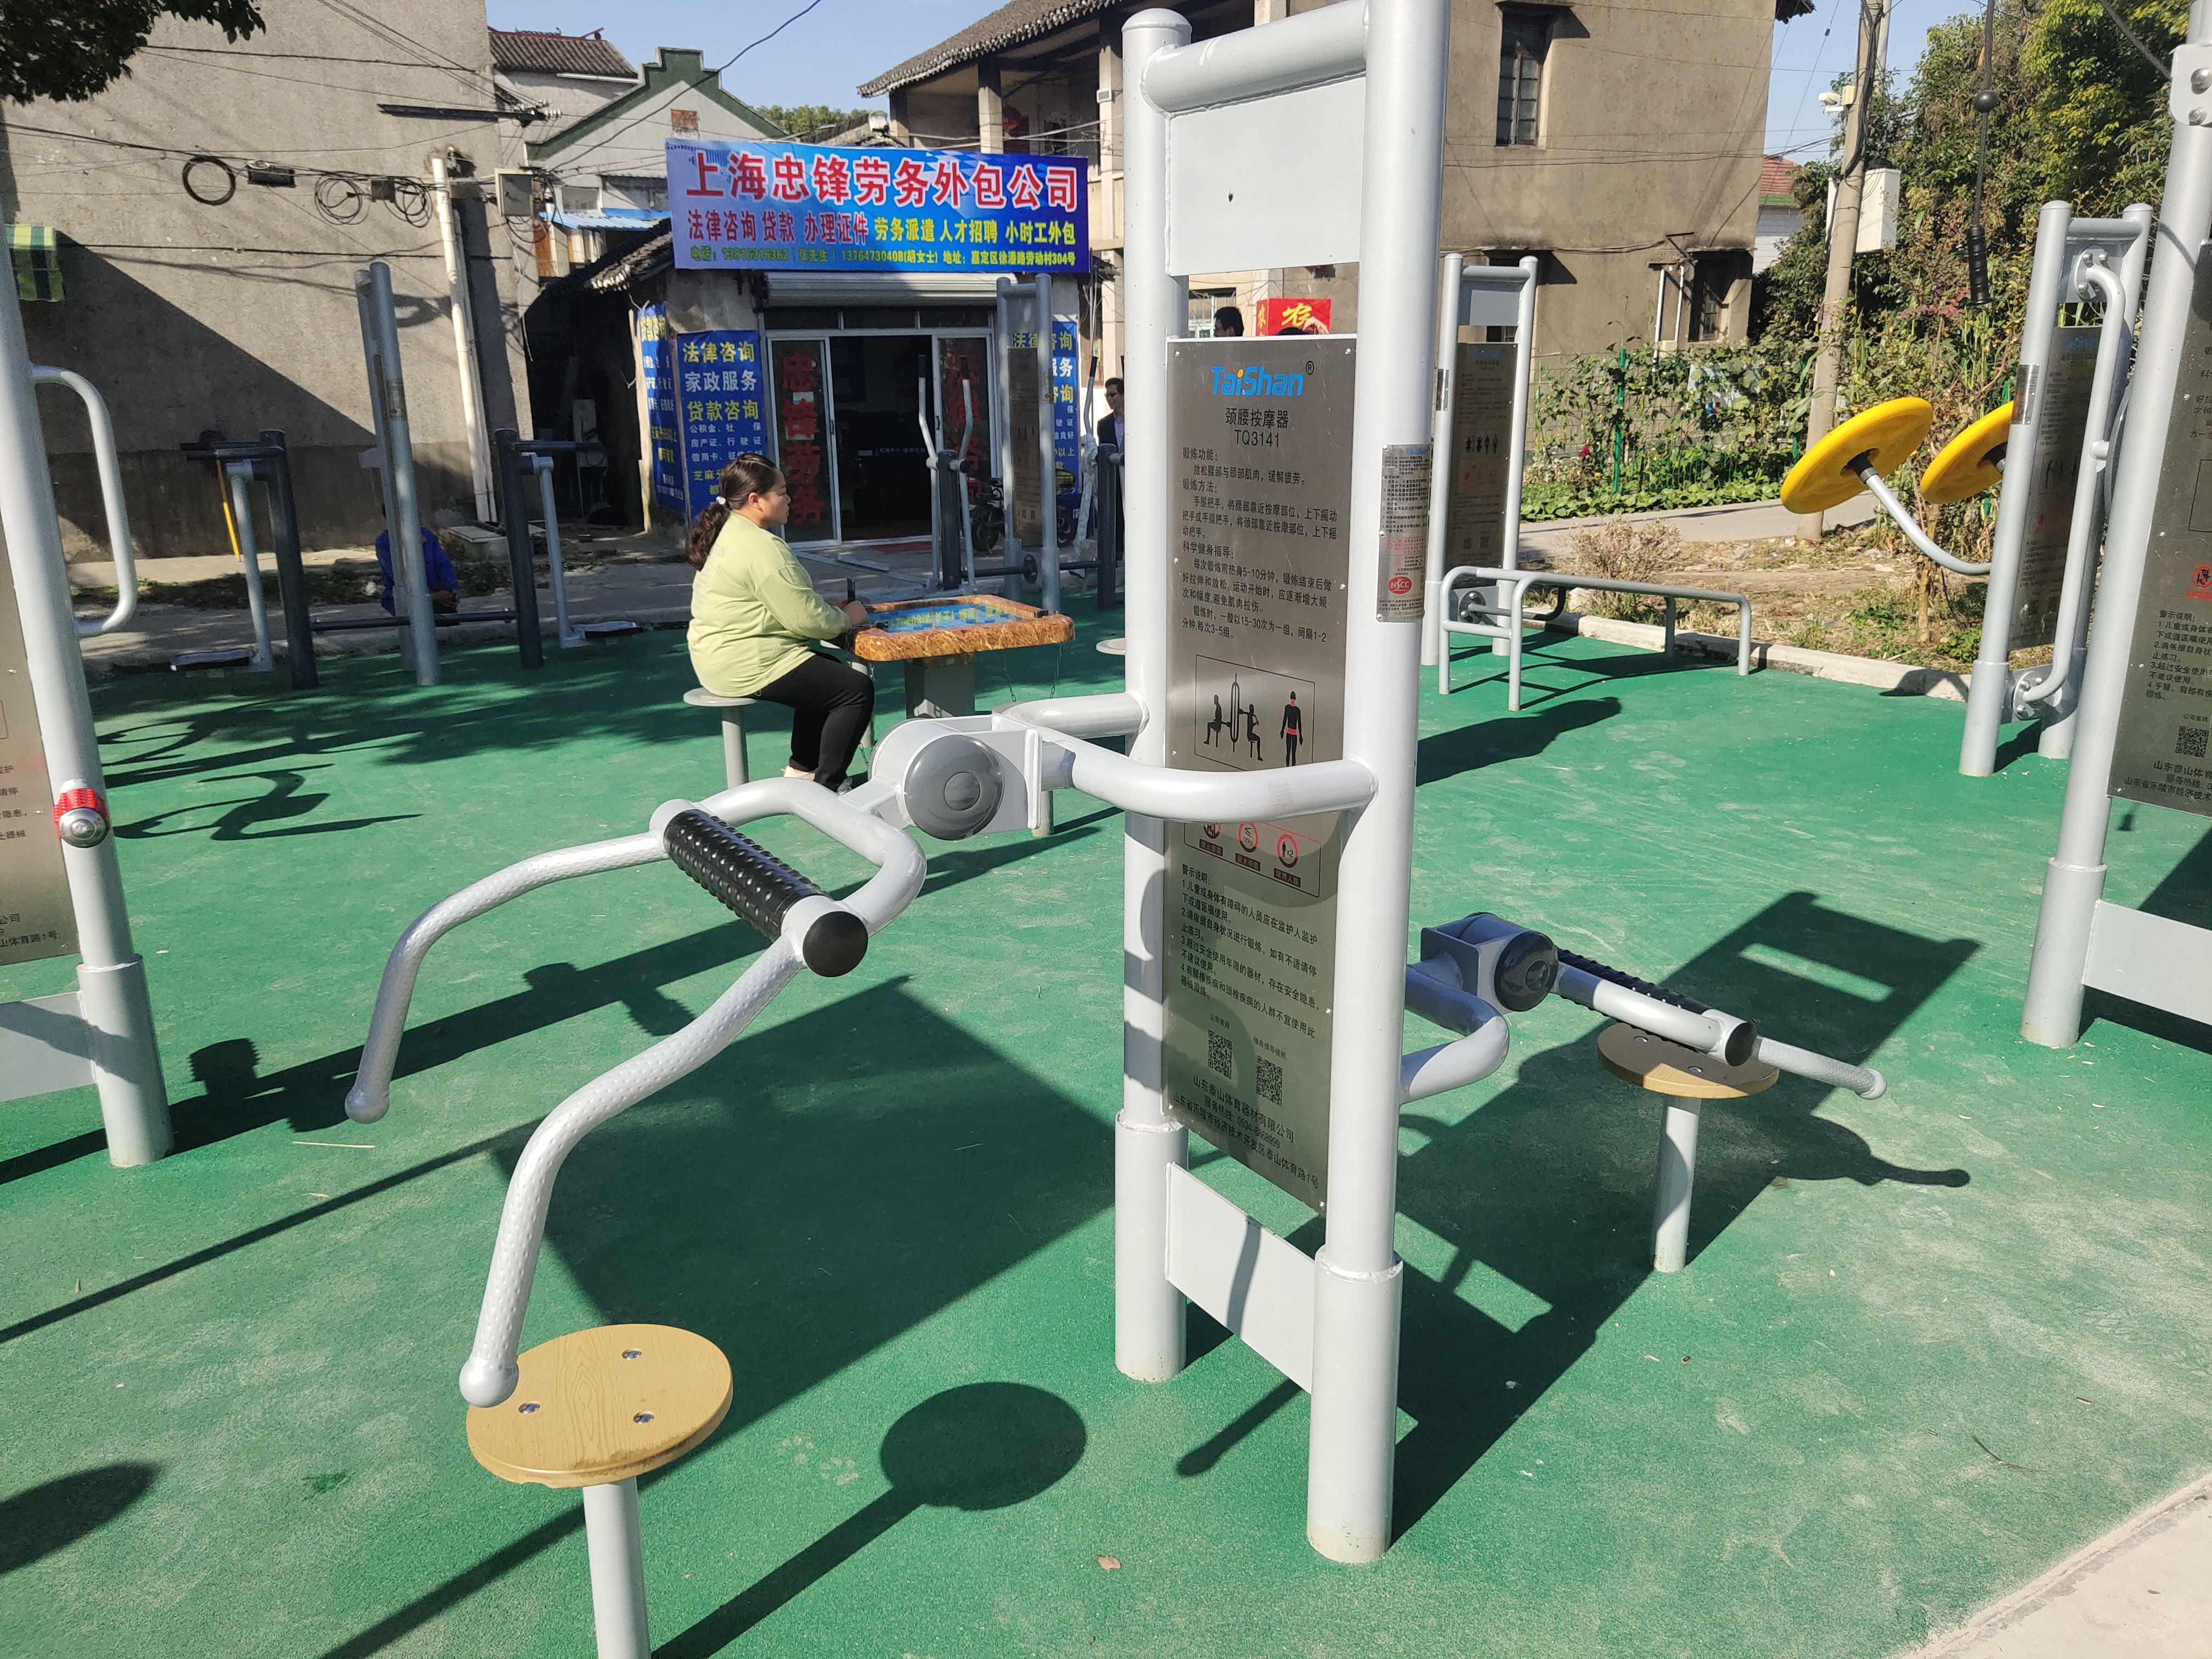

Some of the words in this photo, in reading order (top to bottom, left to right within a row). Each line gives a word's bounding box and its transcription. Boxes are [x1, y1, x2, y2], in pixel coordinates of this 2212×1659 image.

[686, 152, 1076, 210] 上海忠锋劳务外包公司
[687, 210, 756, 242] 法律咨询
[763, 213, 795, 241] 贷款
[804, 213, 868, 246] 办理证件
[874, 217, 935, 242] 劳务派遣
[939, 218, 998, 244] 人才招聘
[1005, 219, 1076, 245] 小时工外包
[682, 341, 755, 363] 法律咨询
[685, 369, 757, 392] 家政服务
[1211, 366, 1304, 396] TaiShan
[687, 399, 759, 422] 贷款咨询
[1225, 408, 1289, 429] 颈腰按摩器
[1234, 430, 1280, 448] TQ3141
[1182, 447, 1218, 462] 锻炼功能：
[1182, 479, 1218, 494] 锻炼方法：
[1182, 526, 1207, 540] 动把手。
[1182, 540, 1234, 560] 科学健身指导：
[1193, 1074, 1294, 1143] 山东泰山体育器材有限公司
